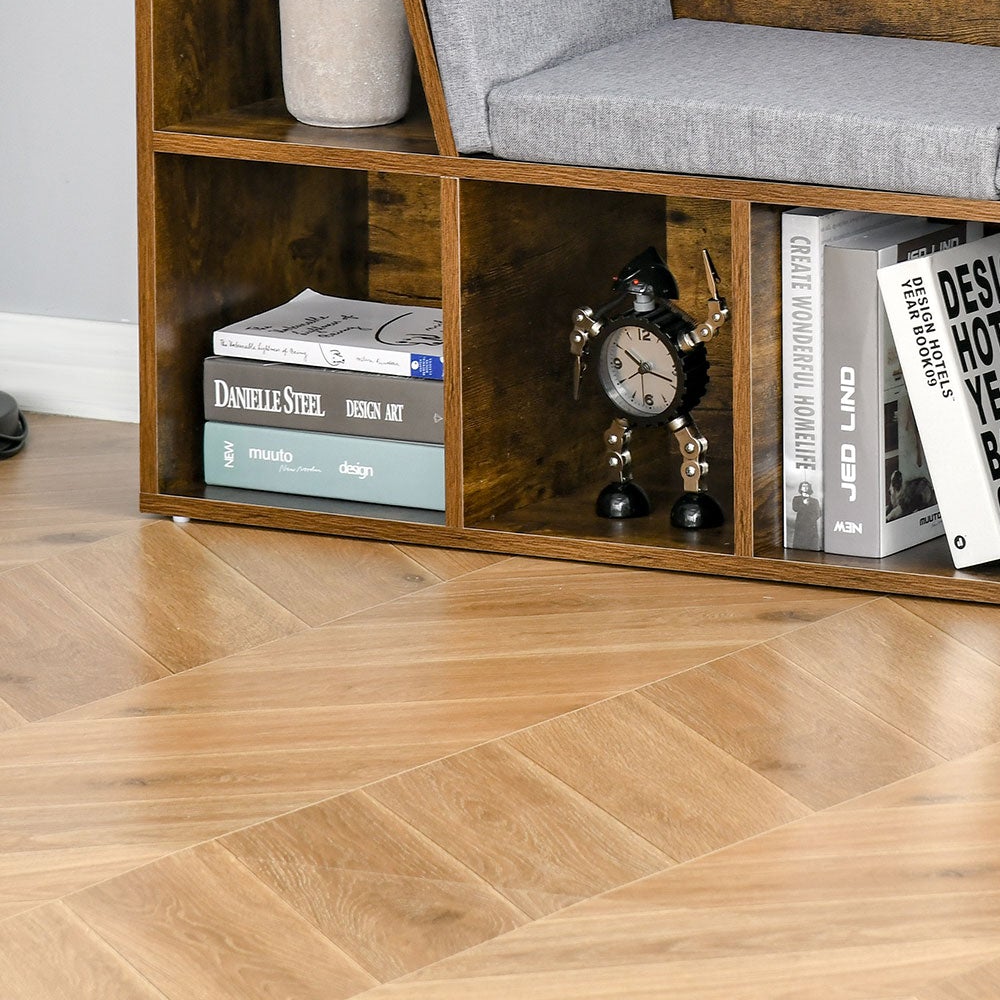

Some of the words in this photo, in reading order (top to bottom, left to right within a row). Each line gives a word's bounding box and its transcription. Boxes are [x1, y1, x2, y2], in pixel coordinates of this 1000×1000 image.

[790, 235, 812, 290] CREATE
[901, 279, 920, 320] YEAR
[638, 328, 651, 341] 12
[792, 296, 815, 389] WONDERFUL
[912, 276, 936, 333] DESIGN
[928, 339, 953, 398] HOTELS
[613, 357, 623, 370] 9
[214, 379, 282, 413] DANIELLE
[283, 385, 325, 417] STEEL
[346, 399, 381, 420] DESIGN
[384, 403, 404, 422] ART
[644, 394, 654, 406] 6
[840, 366, 856, 432] LIND
[793, 394, 816, 471] HOMELIFE
[224, 440, 235, 469] NEW
[249, 448, 293, 463] muuto
[339, 461, 374, 480] design
[841, 443, 857, 502] JED
[834, 521, 863, 534] NEW
